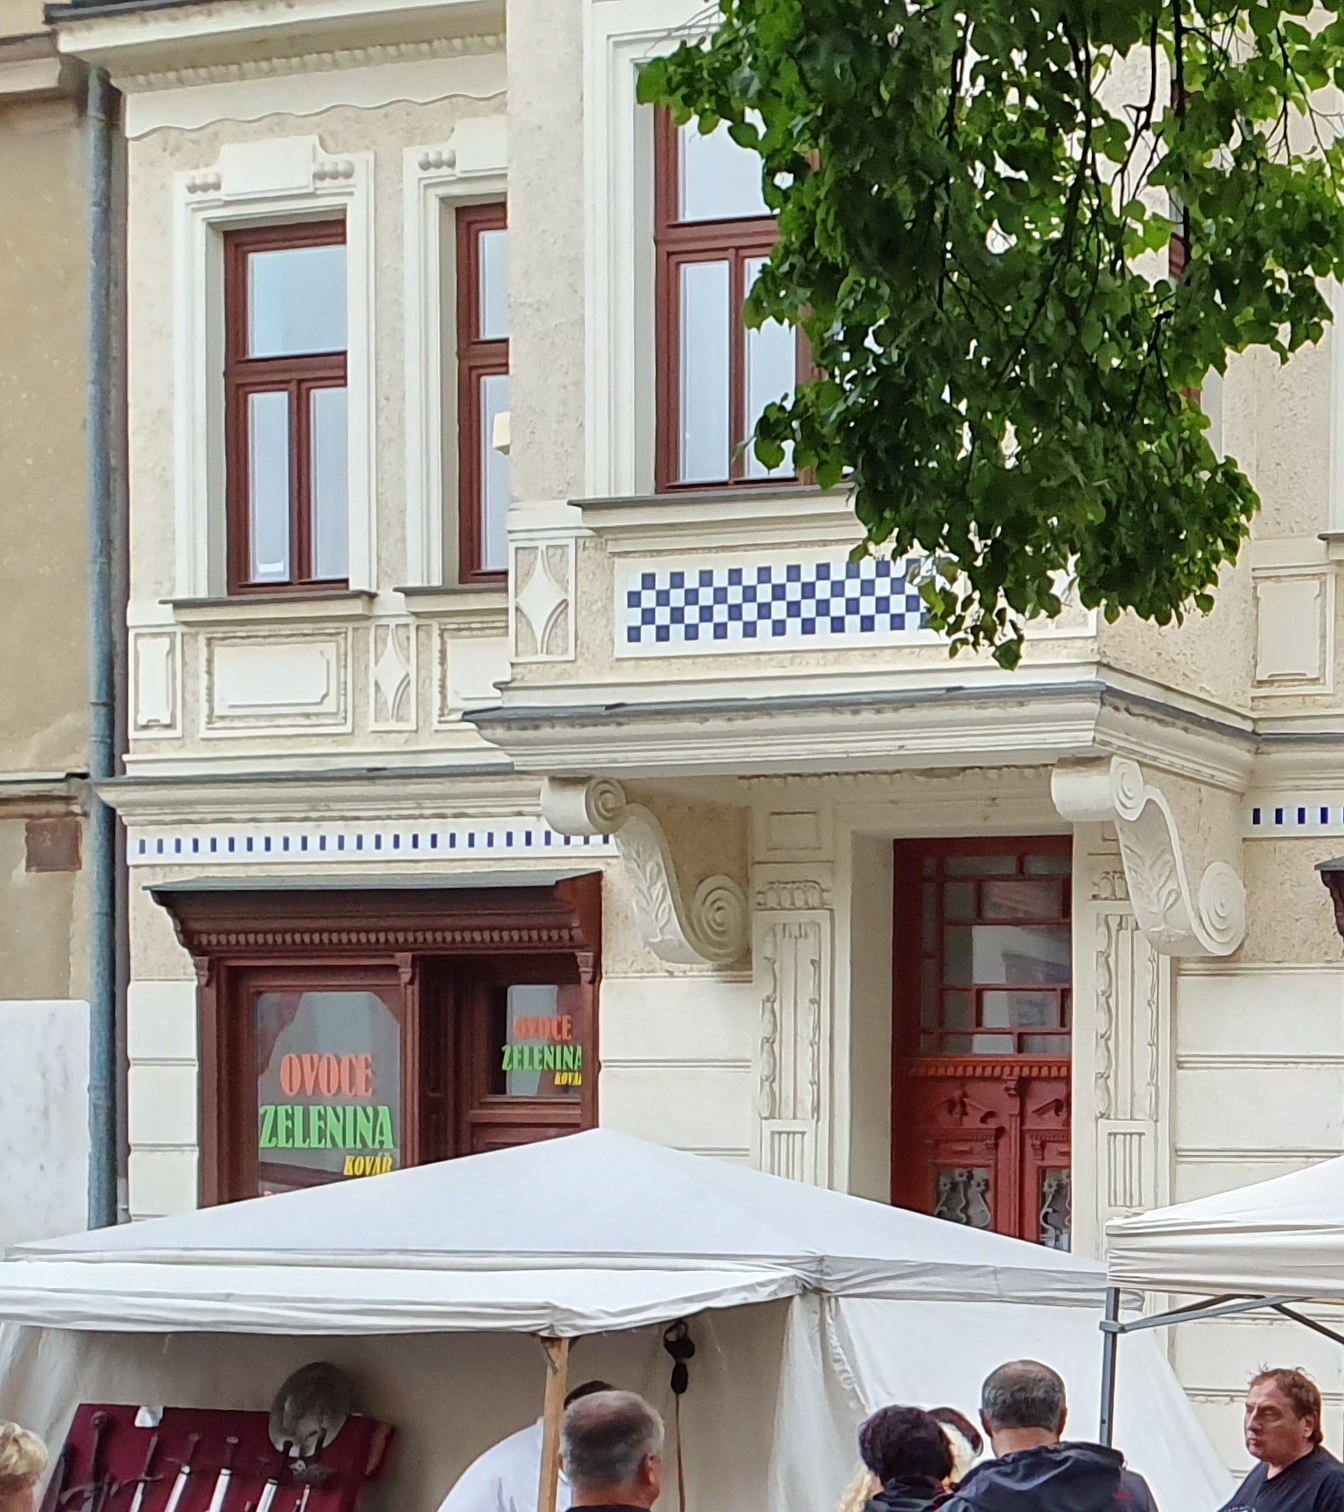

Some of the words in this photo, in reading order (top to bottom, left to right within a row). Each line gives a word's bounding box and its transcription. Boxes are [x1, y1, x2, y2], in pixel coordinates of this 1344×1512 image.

[514, 1014, 572, 1041] OVOCE
[279, 1052, 374, 1098] OVOCE
[501, 1044, 582, 1072] ZELENINA
[259, 1104, 395, 1149] ZELENINA
